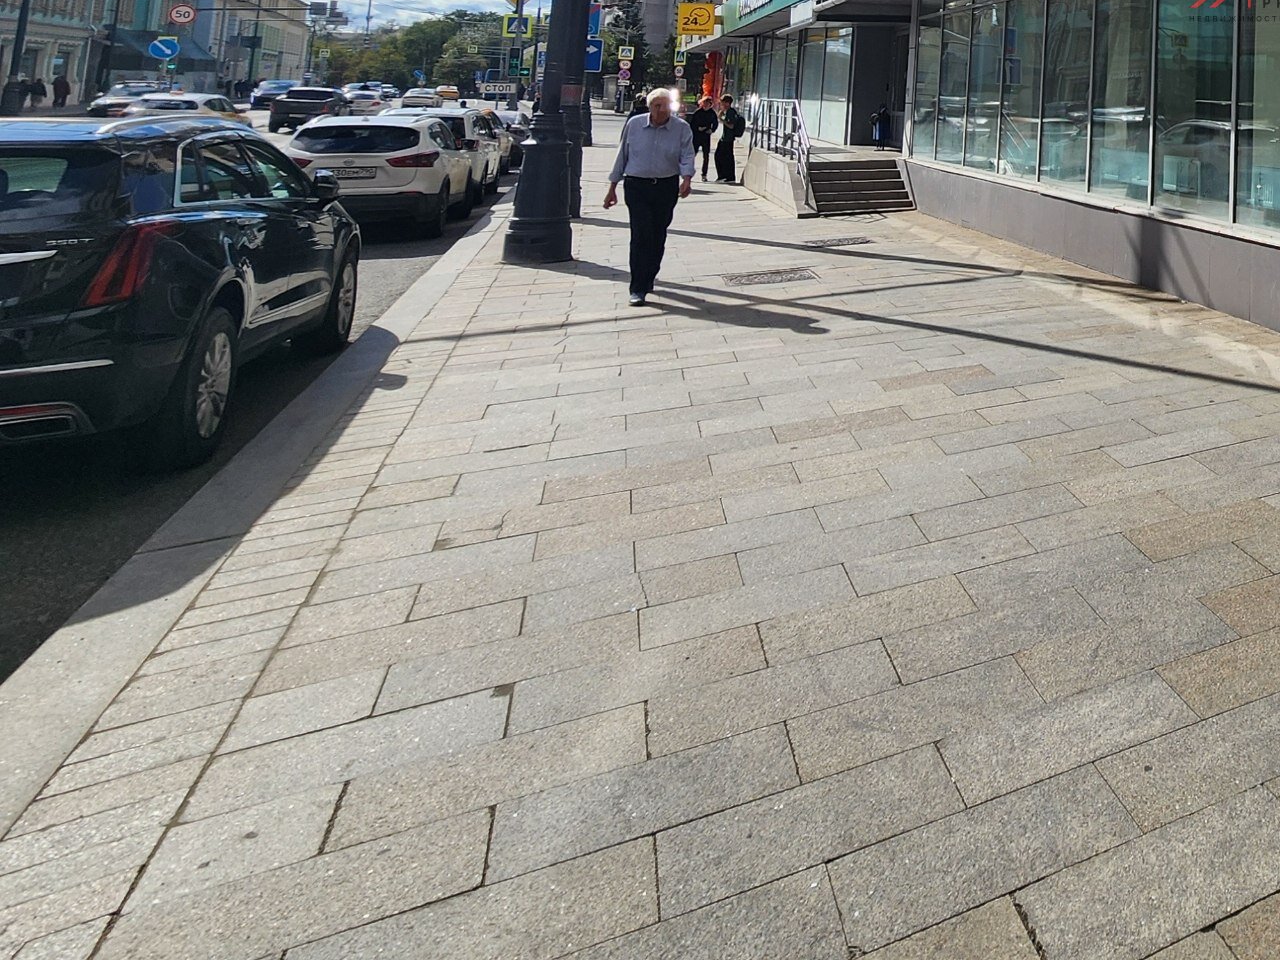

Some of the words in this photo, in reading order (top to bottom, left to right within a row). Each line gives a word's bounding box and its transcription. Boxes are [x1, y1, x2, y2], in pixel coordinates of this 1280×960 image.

[175, 10, 191, 19] 50
[682, 16, 699, 26] 24
[484, 84, 511, 92] СТОП
